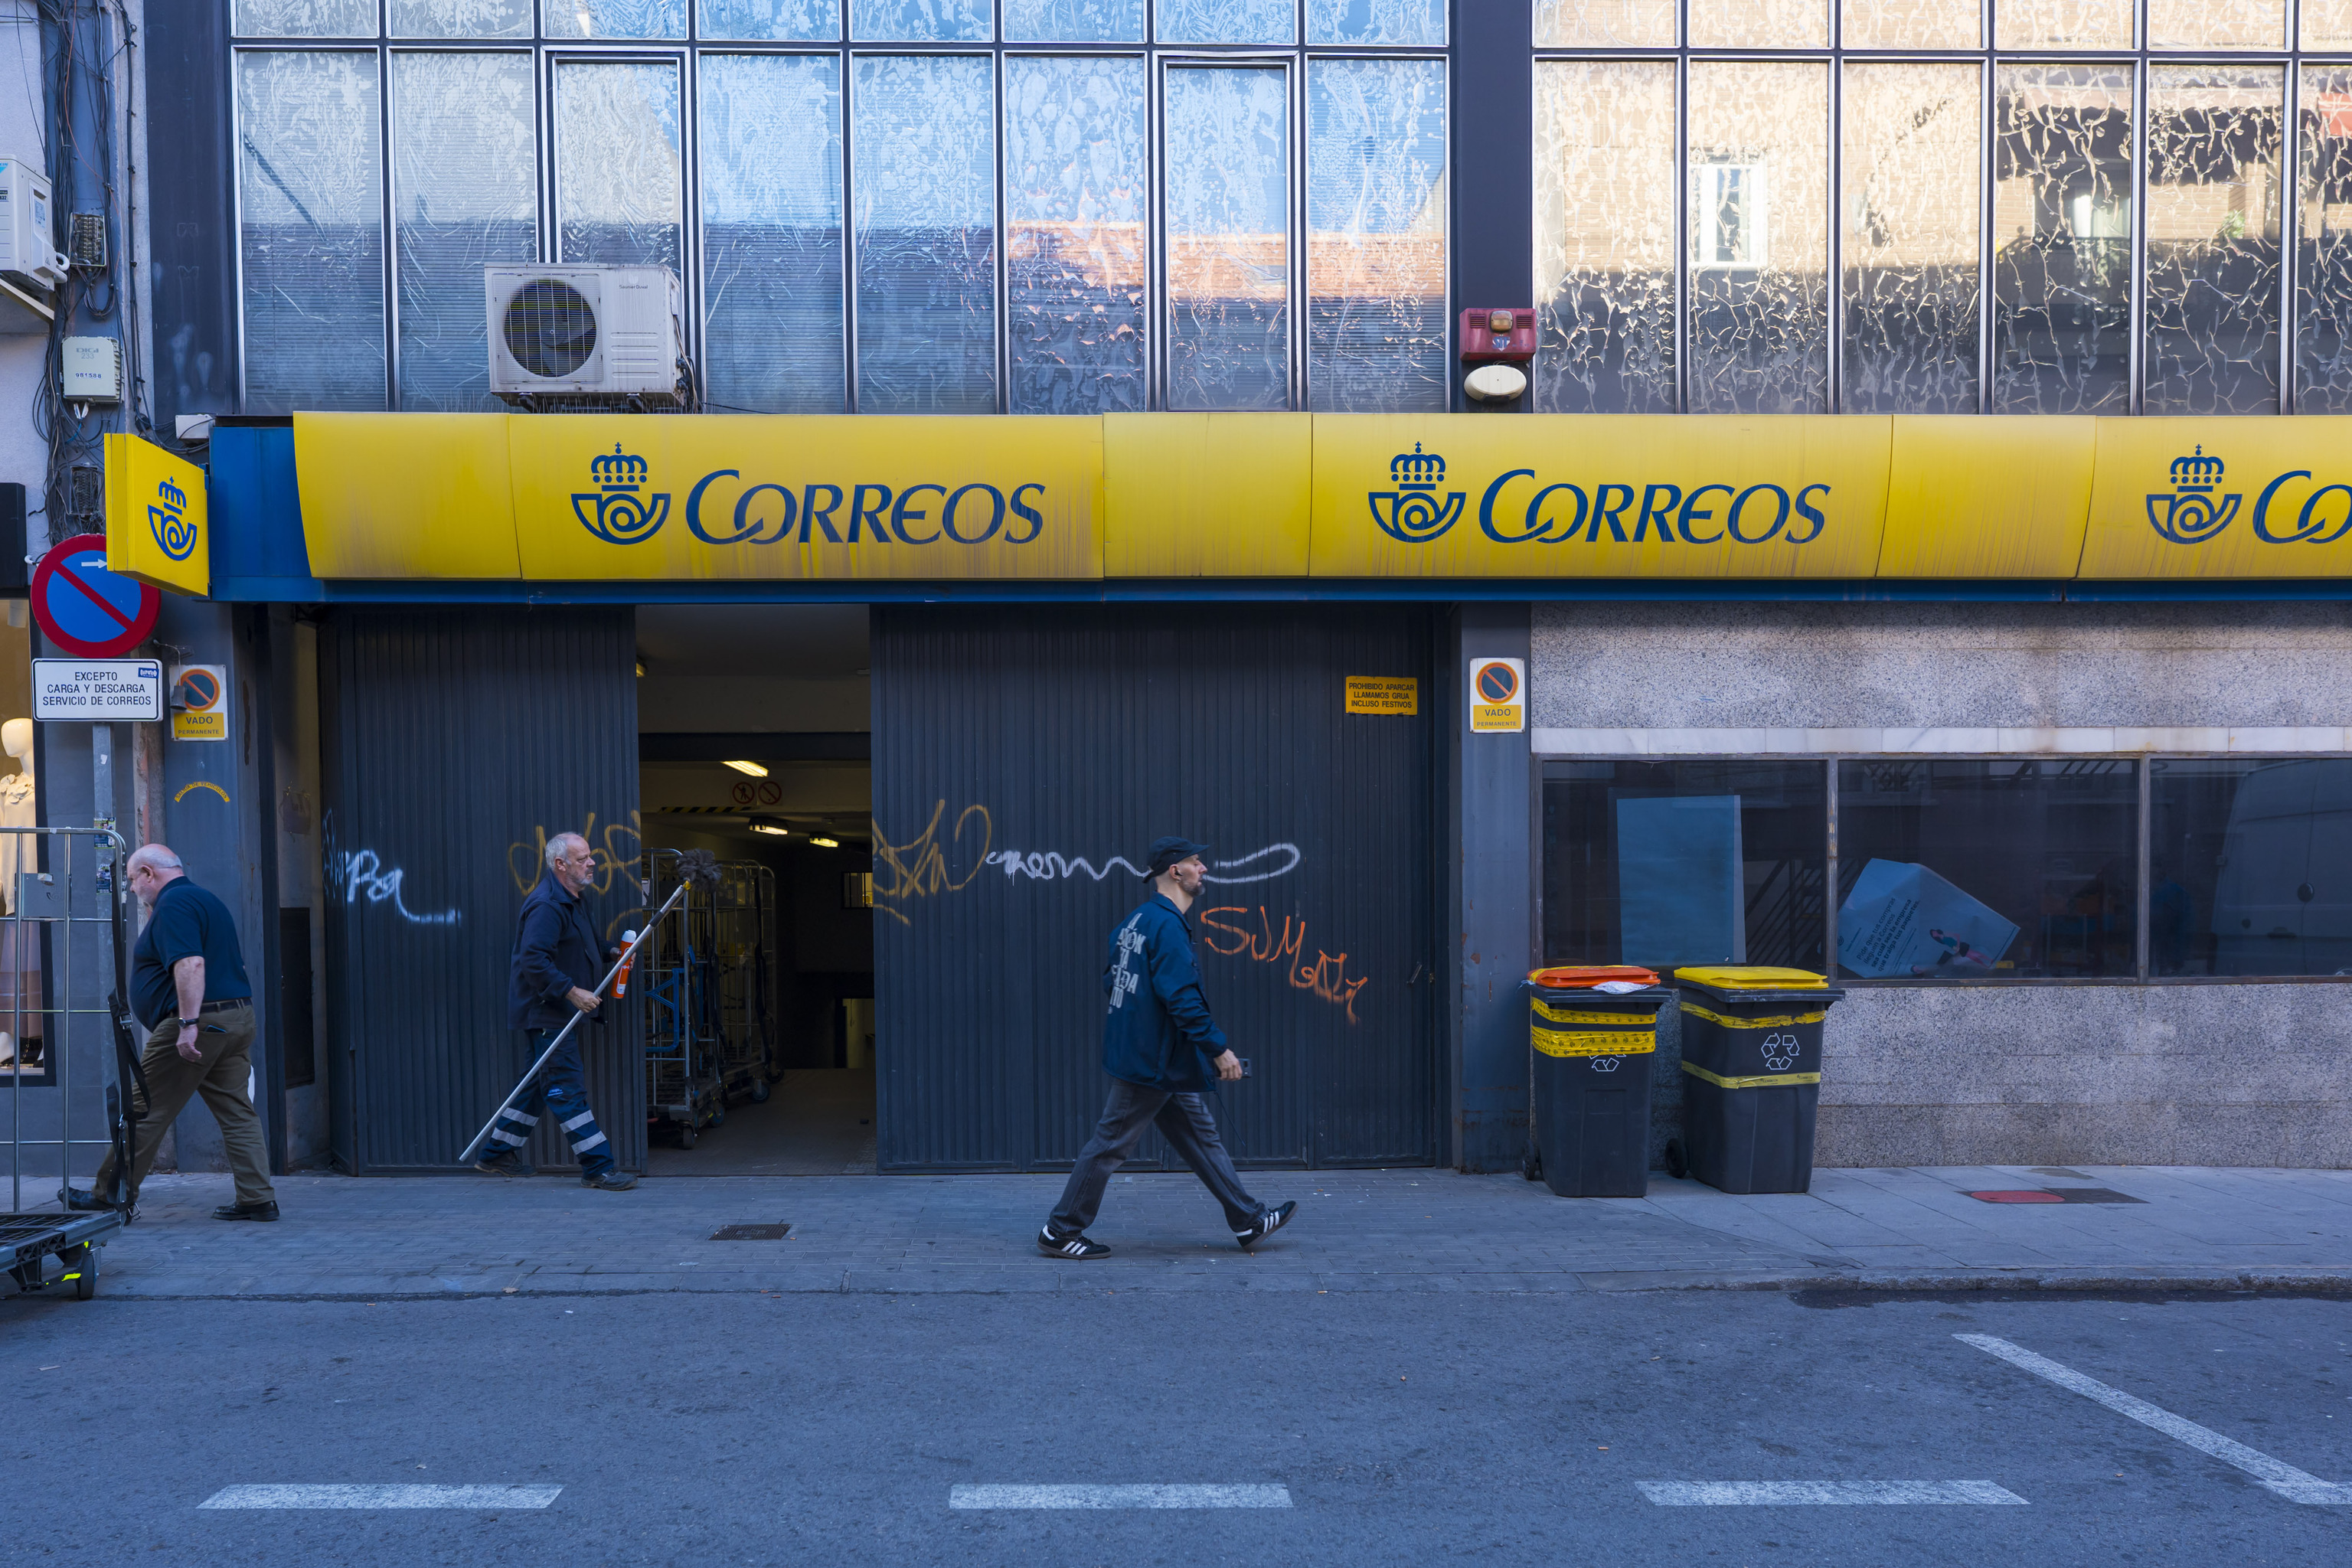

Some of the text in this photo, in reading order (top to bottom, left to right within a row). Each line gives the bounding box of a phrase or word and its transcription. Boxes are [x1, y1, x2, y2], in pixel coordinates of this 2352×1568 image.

[74, 671, 118, 681] EXCEPTO
[47, 684, 145, 693] CARGA Y DESCARGA
[43, 696, 152, 705] SERVICIO DE CORREOS
[1485, 708, 1511, 717] VADO
[185, 716, 213, 724] VADO
[1866, 933, 1875, 946] que
[1879, 897, 1896, 924] compras
[1879, 913, 1895, 937] Correos
[1877, 943, 1886, 956] cual
[1895, 900, 1912, 926] empresa
[1878, 960, 1887, 972] que
[1884, 940, 1897, 959] traiga
